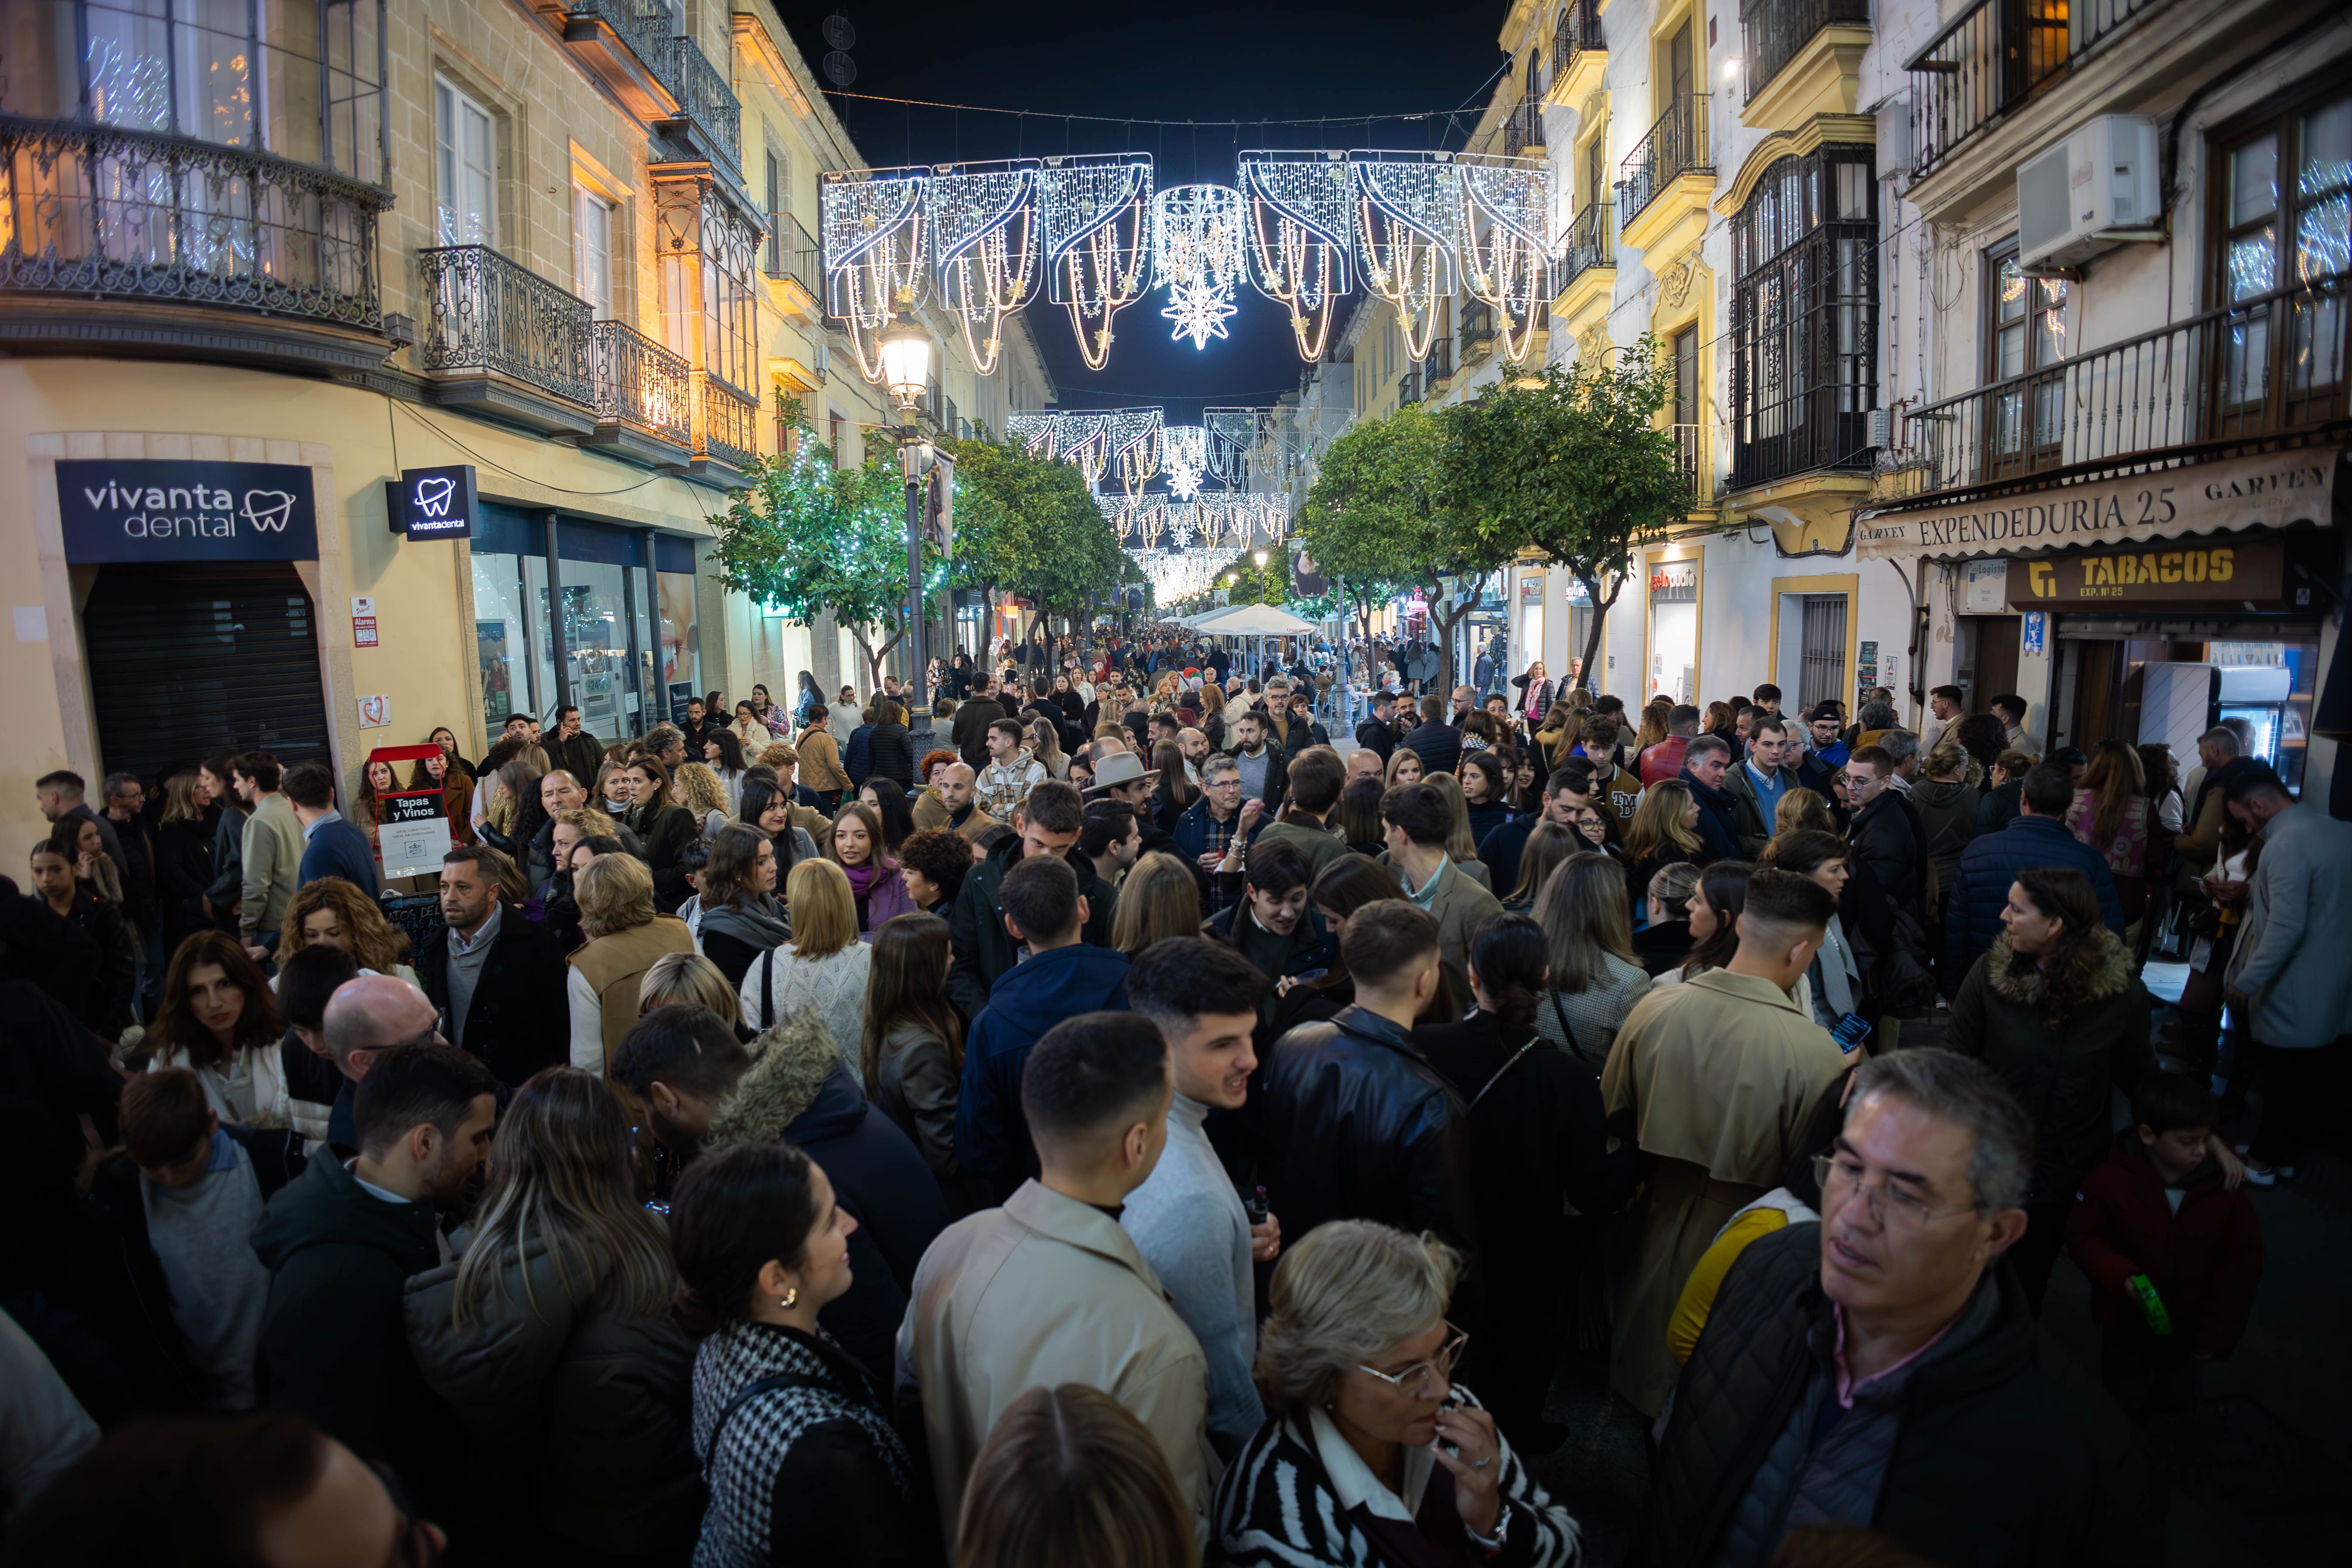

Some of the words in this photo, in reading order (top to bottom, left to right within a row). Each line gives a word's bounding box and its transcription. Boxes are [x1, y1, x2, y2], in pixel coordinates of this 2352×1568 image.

[2205, 466, 2327, 501] GARVEY
[84, 479, 234, 510] vivanta
[124, 511, 236, 537] dental
[412, 519, 464, 530] vivantadental
[1919, 494, 2127, 547] EXPENDEDURIA
[2137, 487, 2176, 525] 25
[1860, 526, 1905, 541] GARVEY
[1979, 564, 2005, 576] Logista
[2081, 548, 2234, 585] TABACOS
[2080, 588, 2098, 597] EXP.
[2111, 587, 2123, 596] 25
[396, 798, 429, 808] Tapas
[393, 812, 400, 820] y
[403, 808, 434, 818] Vinos
